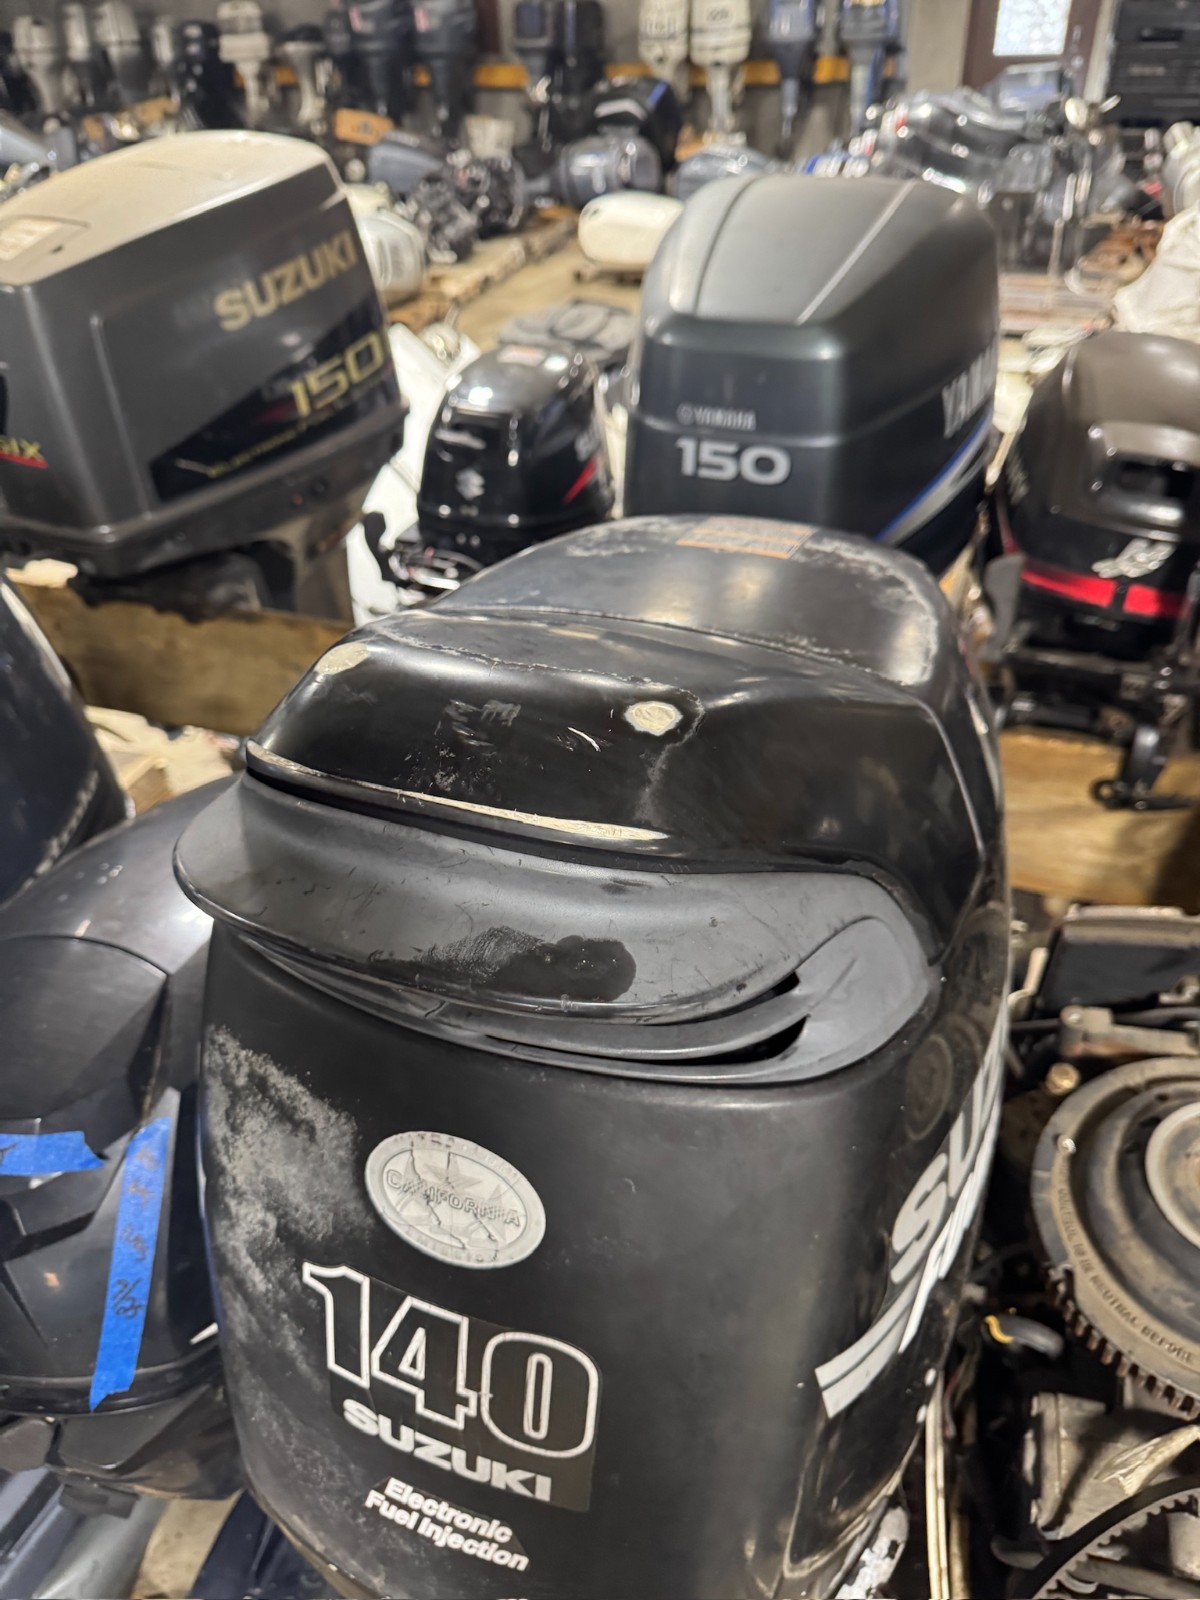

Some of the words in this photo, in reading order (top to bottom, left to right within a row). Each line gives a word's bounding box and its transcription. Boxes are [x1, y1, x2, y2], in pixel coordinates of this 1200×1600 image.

[214, 229, 357, 331] SUZUKI
[290, 330, 384, 417] 150
[675, 436, 792, 485] 150
[302, 1262, 598, 1458] 140
[343, 1399, 551, 1501] SUZUKI
[365, 1489, 420, 1530] Fuel
[417, 1516, 530, 1571] Injection
[384, 1477, 513, 1543] Electronic
